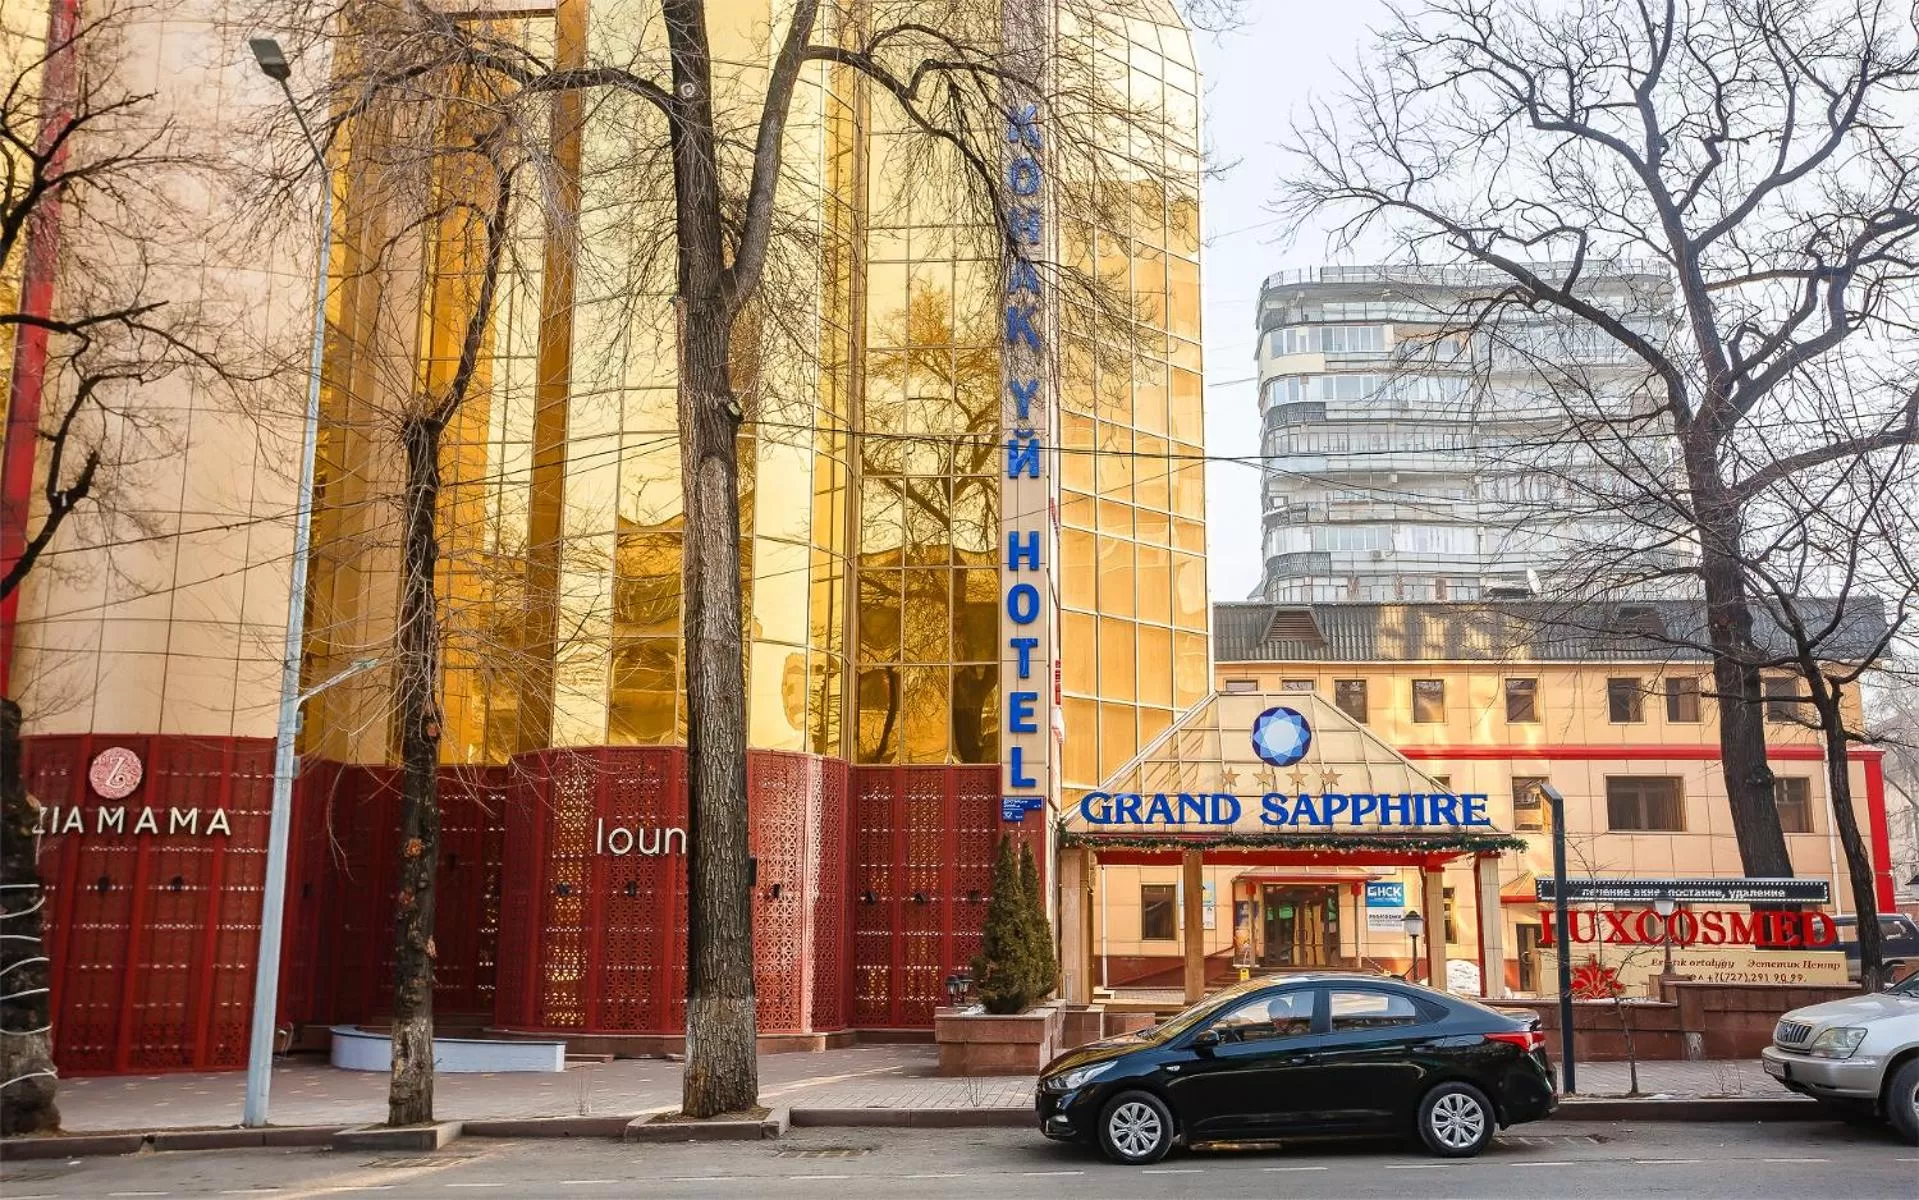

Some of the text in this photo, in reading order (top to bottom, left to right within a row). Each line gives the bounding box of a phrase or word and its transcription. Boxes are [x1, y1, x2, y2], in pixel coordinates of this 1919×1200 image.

[1007, 530, 1041, 789] HOTEL
[1080, 791, 1492, 827] GRAND SAPPHIRE
